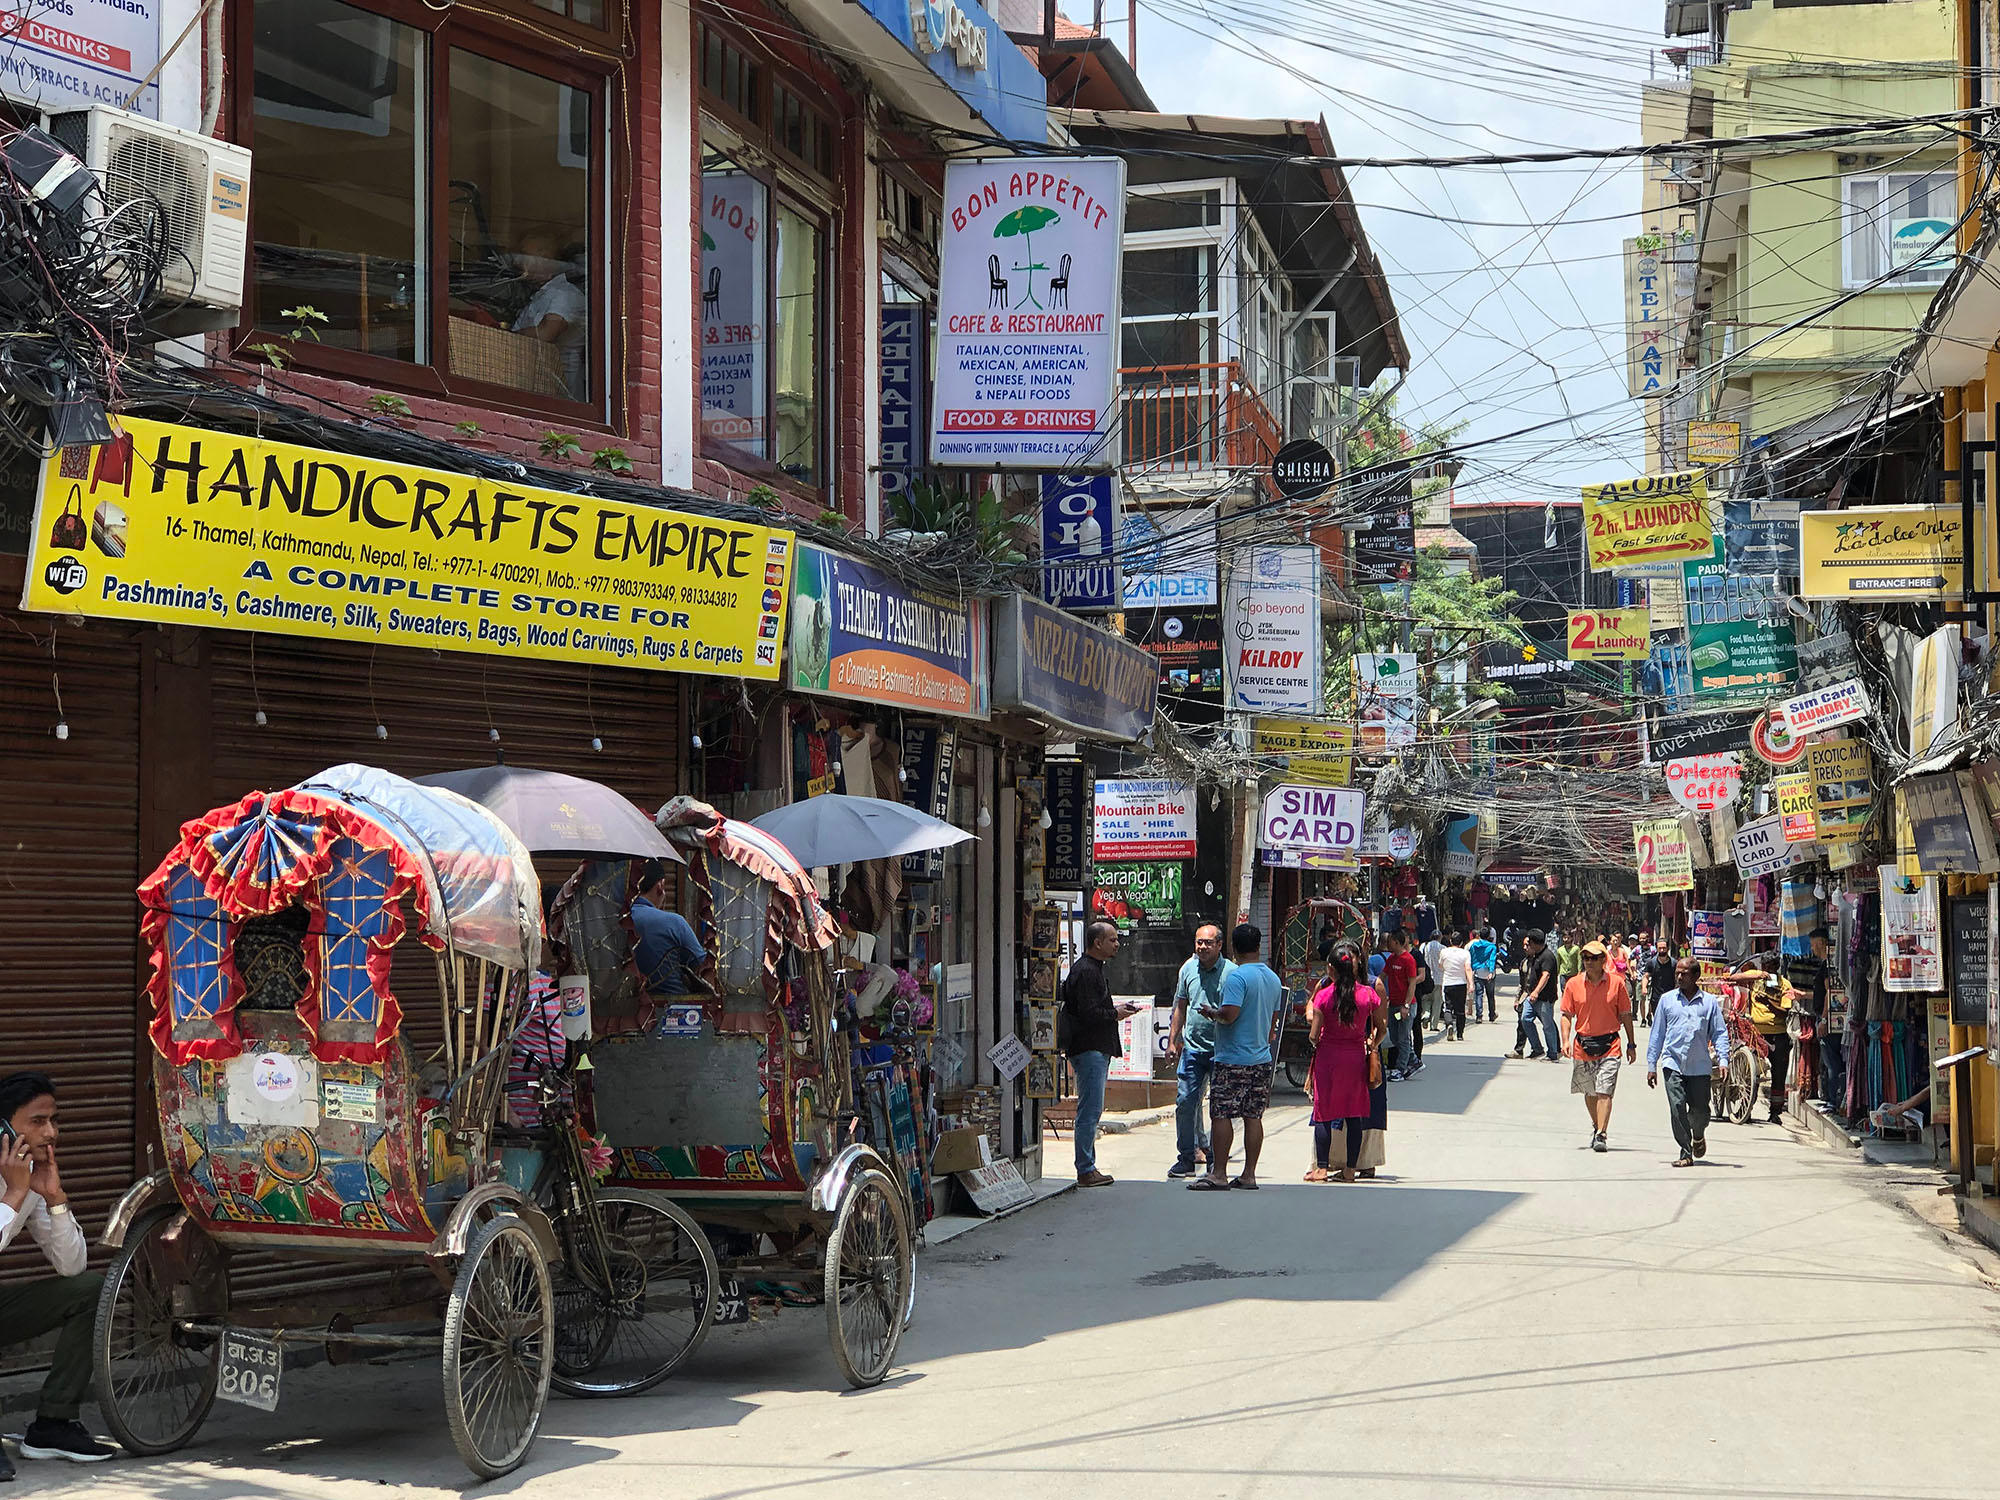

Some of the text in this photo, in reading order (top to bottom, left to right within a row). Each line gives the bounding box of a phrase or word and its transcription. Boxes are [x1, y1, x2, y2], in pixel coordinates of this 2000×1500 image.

[28, 22, 111, 61] DRINKS
[30, 64, 143, 112] TERRACE AC HALL
[951, 172, 1108, 233] BON APPETIT
[1008, 314, 1104, 333] RESTAURANT
[959, 360, 1089, 371] MEXICAN, AMERICAN,
[1641, 330, 1663, 392] NANA
[975, 375, 1076, 386] CHINESE, INDIAN,
[987, 390, 1071, 400] NEPALI FOODS
[947, 412, 1092, 426] FOOD DRINKS
[940, 443, 1053, 454] DINNING WITH SUNNY TERRACE
[1278, 462, 1330, 477] SHISHA
[1598, 473, 1693, 502] A-One
[150, 434, 755, 579] HANDICRAFTS EMPIRE
[1592, 500, 1702, 536] 2 hr. LAUNDRY
[1730, 522, 1775, 530] Adventure
[1613, 532, 1688, 548] Fast Service
[1834, 519, 1961, 554] La dolce Vita
[770, 544, 785, 555] VISA
[192, 520, 256, 549] Thamel,
[261, 529, 355, 563] Kathmandu,
[360, 545, 408, 570] Nepal,
[413, 550, 439, 572] Tel.:
[546, 570, 581, 591] Mob.:
[583, 575, 610, 594] +977
[612, 578, 677, 604] 9803793349,
[680, 586, 738, 609] 9813343812
[1050, 559, 1112, 598] DEPOT
[1855, 578, 1932, 588] ENTRANCE HERE
[242, 559, 691, 630] A COMPLETE STORE FOR
[1250, 602, 1305, 616] go beyond
[102, 574, 744, 666] Pashmina's, Cashmere, Silk, Sweaters, Bags, Wood Carvings, Rugs Carpets
[838, 581, 967, 659] THAMEL PASHMINA POINT
[1757, 617, 1791, 629] PUB
[1571, 612, 1622, 650] 2 hr
[1729, 635, 1743, 644] Food,
[1743, 634, 1756, 643] Wine,
[1032, 615, 1079, 683] NEPAL
[1596, 634, 1646, 651] Laundry
[757, 644, 775, 659] SCT
[1514, 662, 1548, 676] Lounge
[1556, 659, 1575, 672] Bar
[1731, 658, 1747, 668] Music,
[838, 657, 967, 705] a Complete Pashmina House
[1239, 675, 1309, 688] SERVICE CENTRE
[1374, 680, 1414, 688] ARADISE
[1789, 699, 1819, 713] Sim
[1820, 684, 1857, 702] Card
[1790, 698, 1852, 726] LAUNDRY
[1816, 713, 1842, 725] INSIDE
[1261, 735, 1346, 752] EAGLE EXPORT
[1655, 735, 1688, 758] LIVE
[1812, 746, 1866, 765] EXOTIC MT.
[1666, 762, 1744, 781] Orleans
[1814, 765, 1843, 781] TREKS
[1683, 780, 1729, 800] Café
[1095, 803, 1186, 818] Mountain Bike
[1282, 790, 1337, 817] SIM
[1055, 767, 1073, 865] NEPAL BOOK
[1102, 820, 1175, 829] SALE HIRE
[1103, 831, 1188, 840] TOURS REPAIR
[1268, 817, 1355, 845] CARD
[1738, 830, 1769, 850] SIM
[1097, 850, 1192, 859] www.nepalmountainbiketours.com
[1638, 833, 1668, 874] 2 hr
[1658, 842, 1687, 856] LAUNDRY
[1742, 846, 1775, 863] CARD
[1049, 868, 1079, 881] DEPOT
[1097, 868, 1151, 890] Sarangi
[1098, 889, 1152, 902] Veg Vegan
[1961, 930, 1970, 940] LA
[1968, 942, 1987, 952] HAPPY
